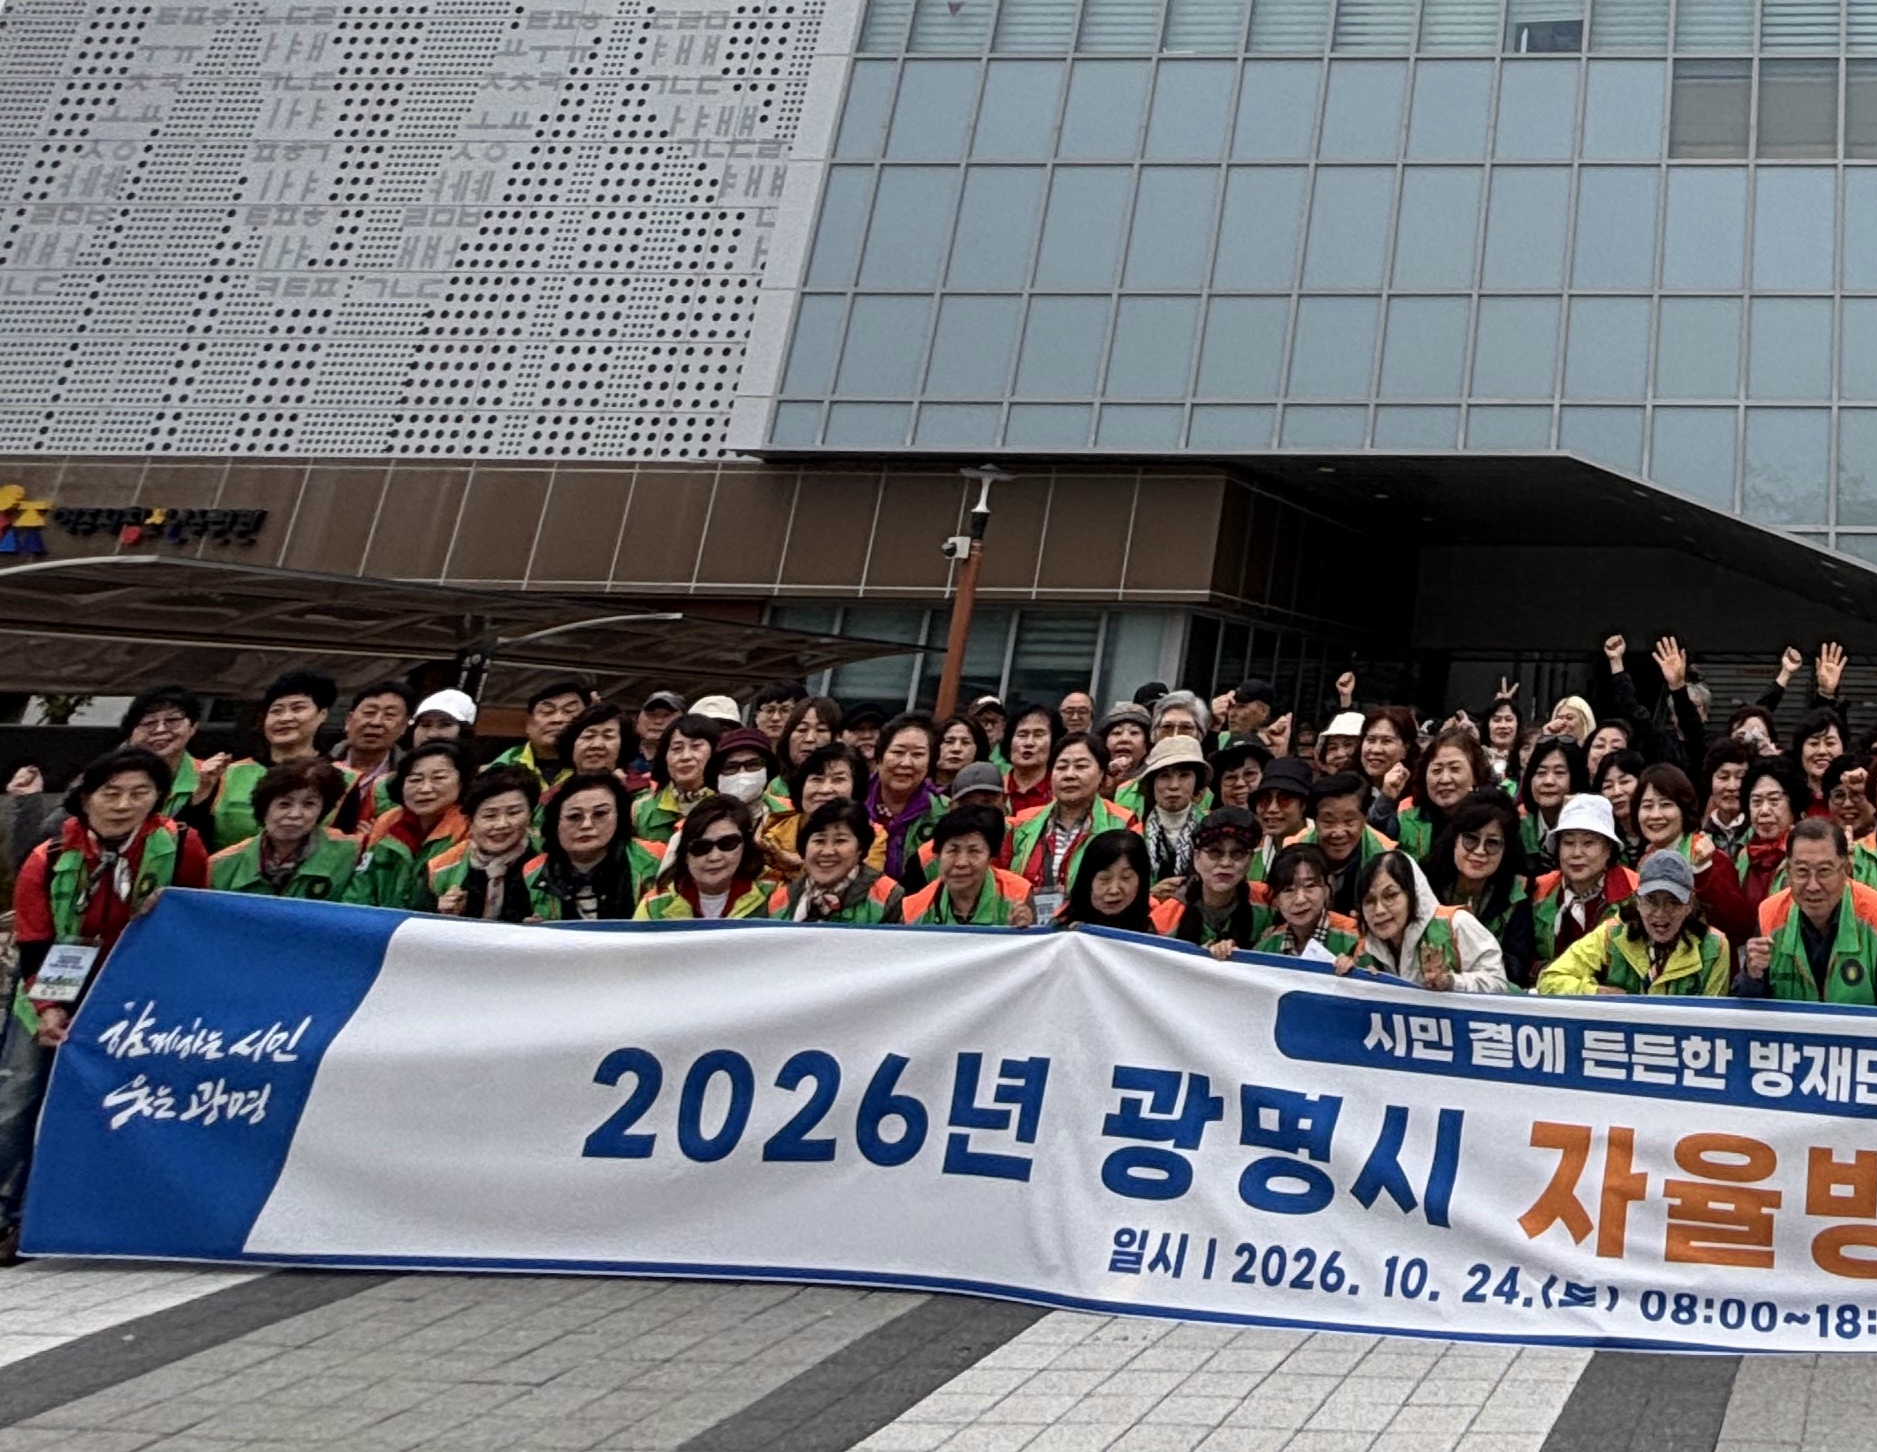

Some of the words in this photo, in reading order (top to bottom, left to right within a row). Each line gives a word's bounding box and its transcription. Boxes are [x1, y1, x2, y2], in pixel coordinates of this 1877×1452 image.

[99, 1001, 224, 1058] 함께하는
[230, 1016, 312, 1062] 시민
[1364, 1013, 1453, 1062] 시민
[1468, 1021, 1565, 1074] 곁에
[1581, 1031, 1732, 1090] 든든한
[180, 1080, 271, 1125] 광명
[582, 1047, 1050, 1183] 2026년
[1101, 1066, 1465, 1229] 광명시
[1108, 1227, 1189, 1279] 일시
[1231, 1242, 1360, 1295] 2026.
[1383, 1256, 1440, 1301] 10.
